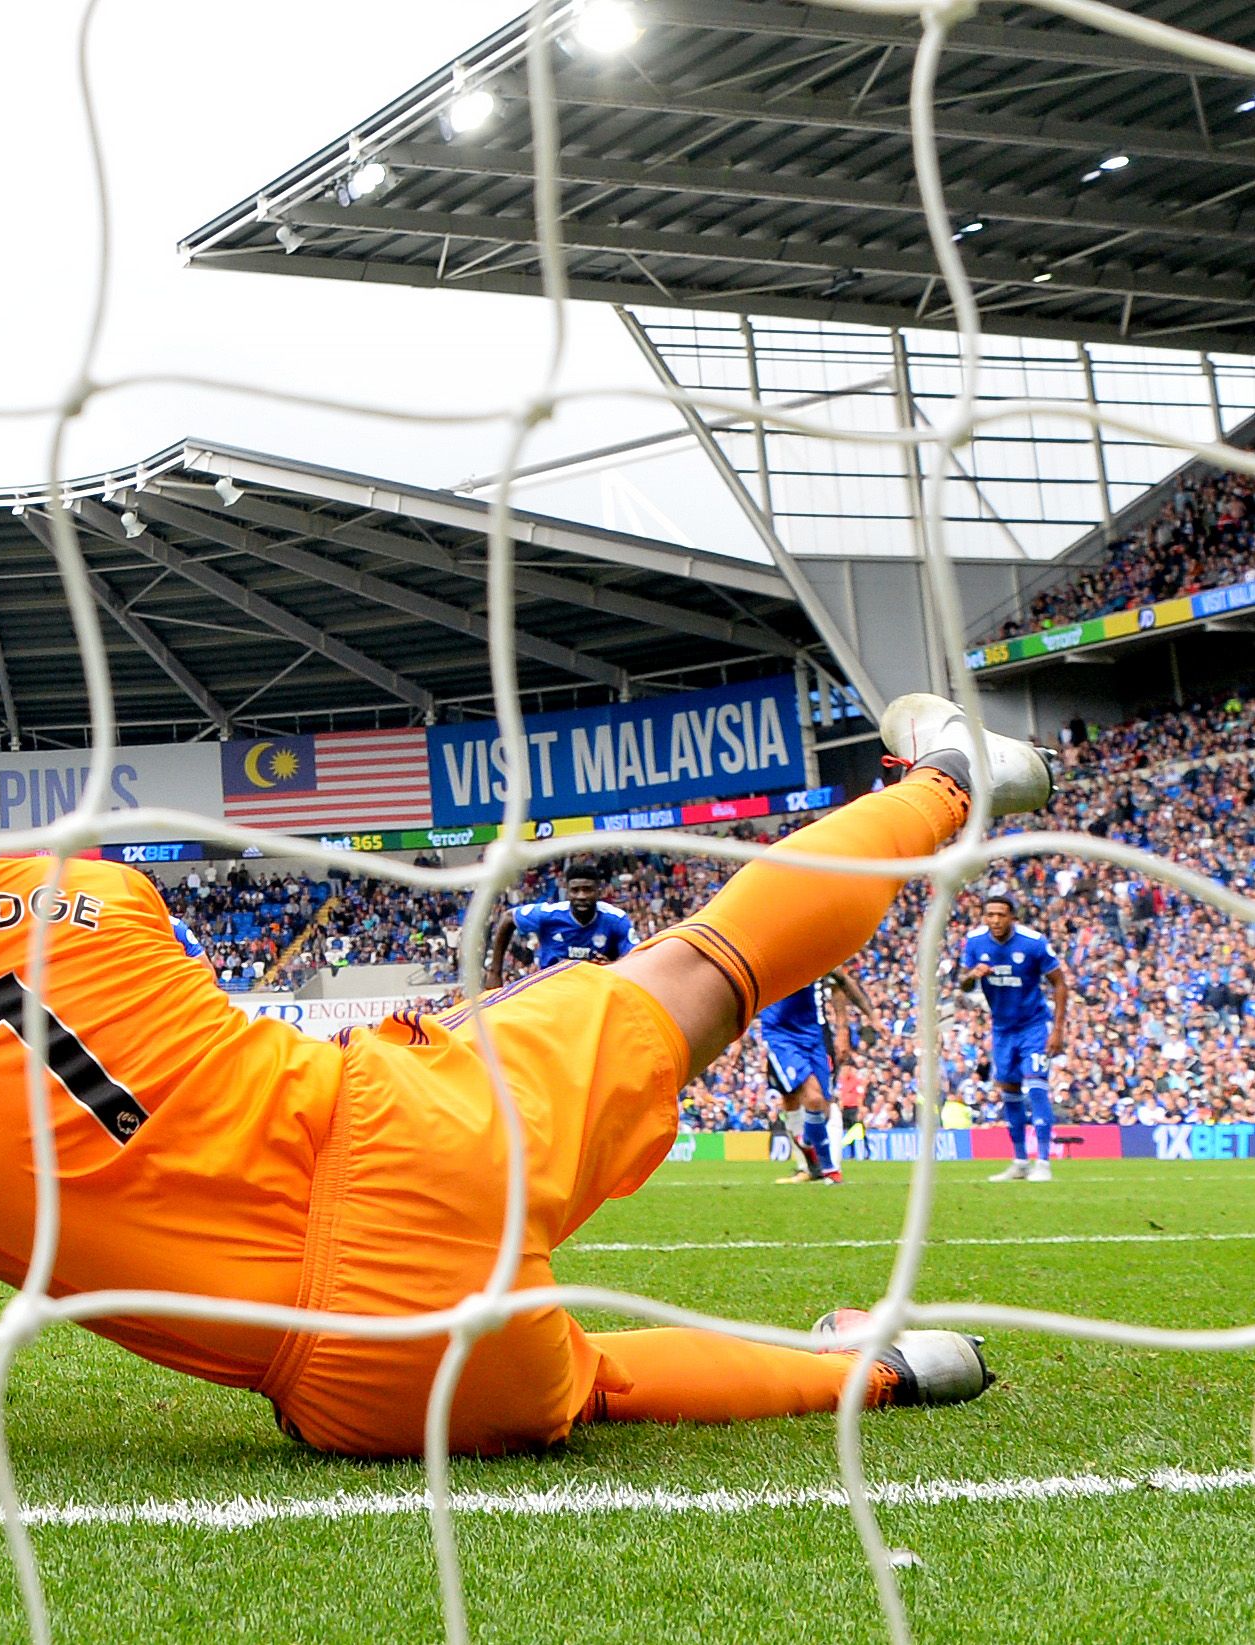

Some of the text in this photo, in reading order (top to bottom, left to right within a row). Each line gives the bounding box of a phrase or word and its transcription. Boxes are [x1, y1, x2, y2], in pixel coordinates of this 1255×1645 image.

[443, 697, 790, 807] VISIT MALAYSIA
[122, 844, 183, 862] 1XBET
[1153, 1124, 1255, 1160] 1XBET
